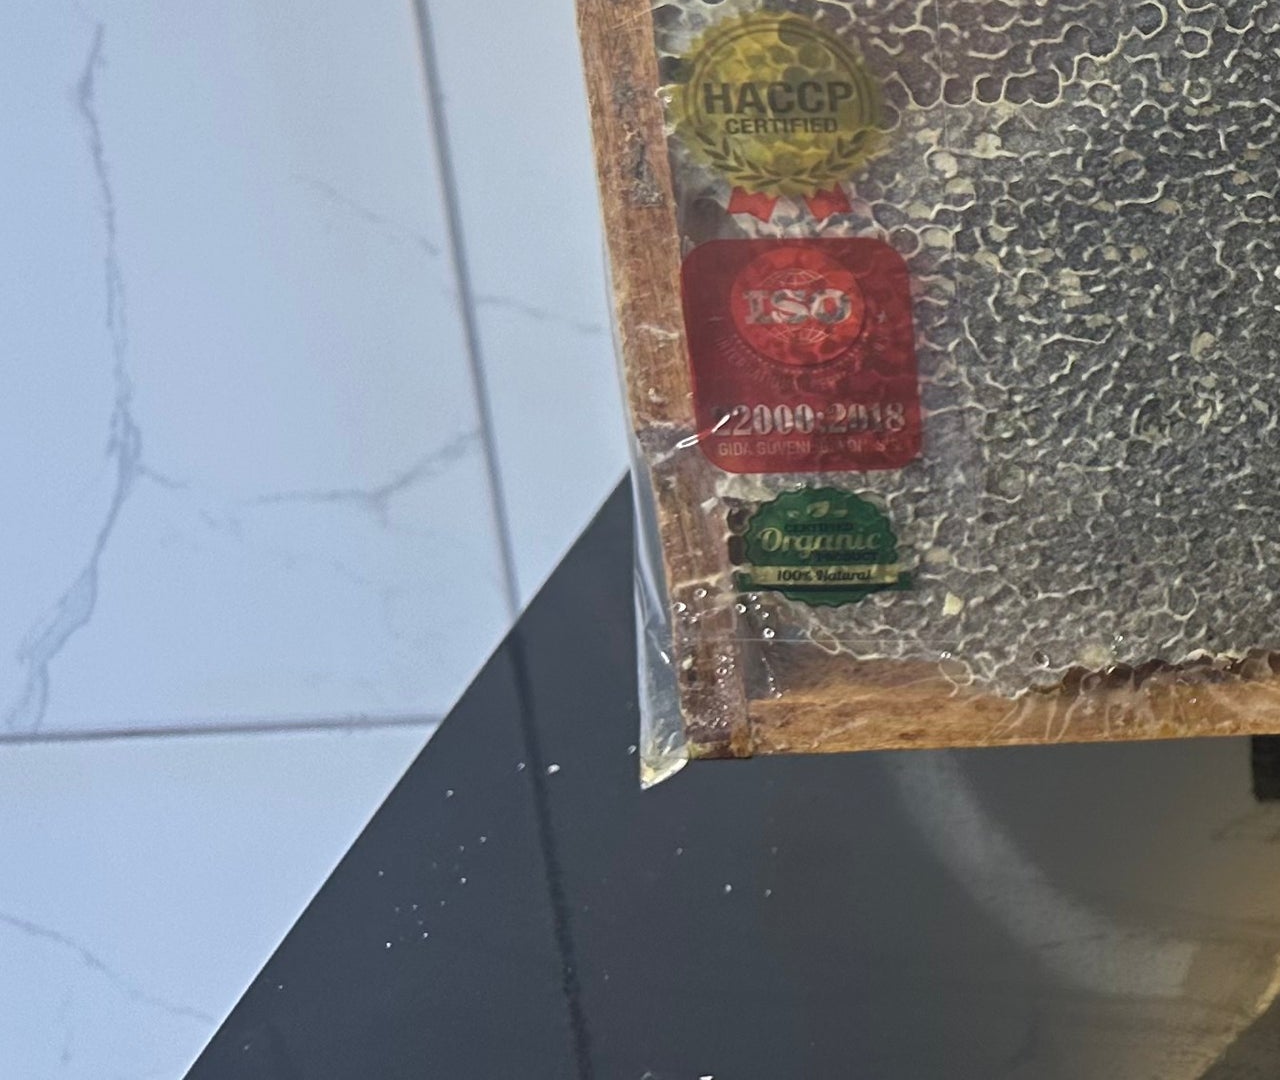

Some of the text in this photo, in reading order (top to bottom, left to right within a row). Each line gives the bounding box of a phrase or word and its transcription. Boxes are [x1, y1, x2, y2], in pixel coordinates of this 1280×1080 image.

[703, 81, 853, 114] HACCP
[725, 117, 839, 135] CERTIFIED
[742, 289, 852, 324] ISO
[710, 402, 905, 437] 22000:2018
[758, 526, 881, 559] Organic
[777, 569, 873, 582] 100% Natural
